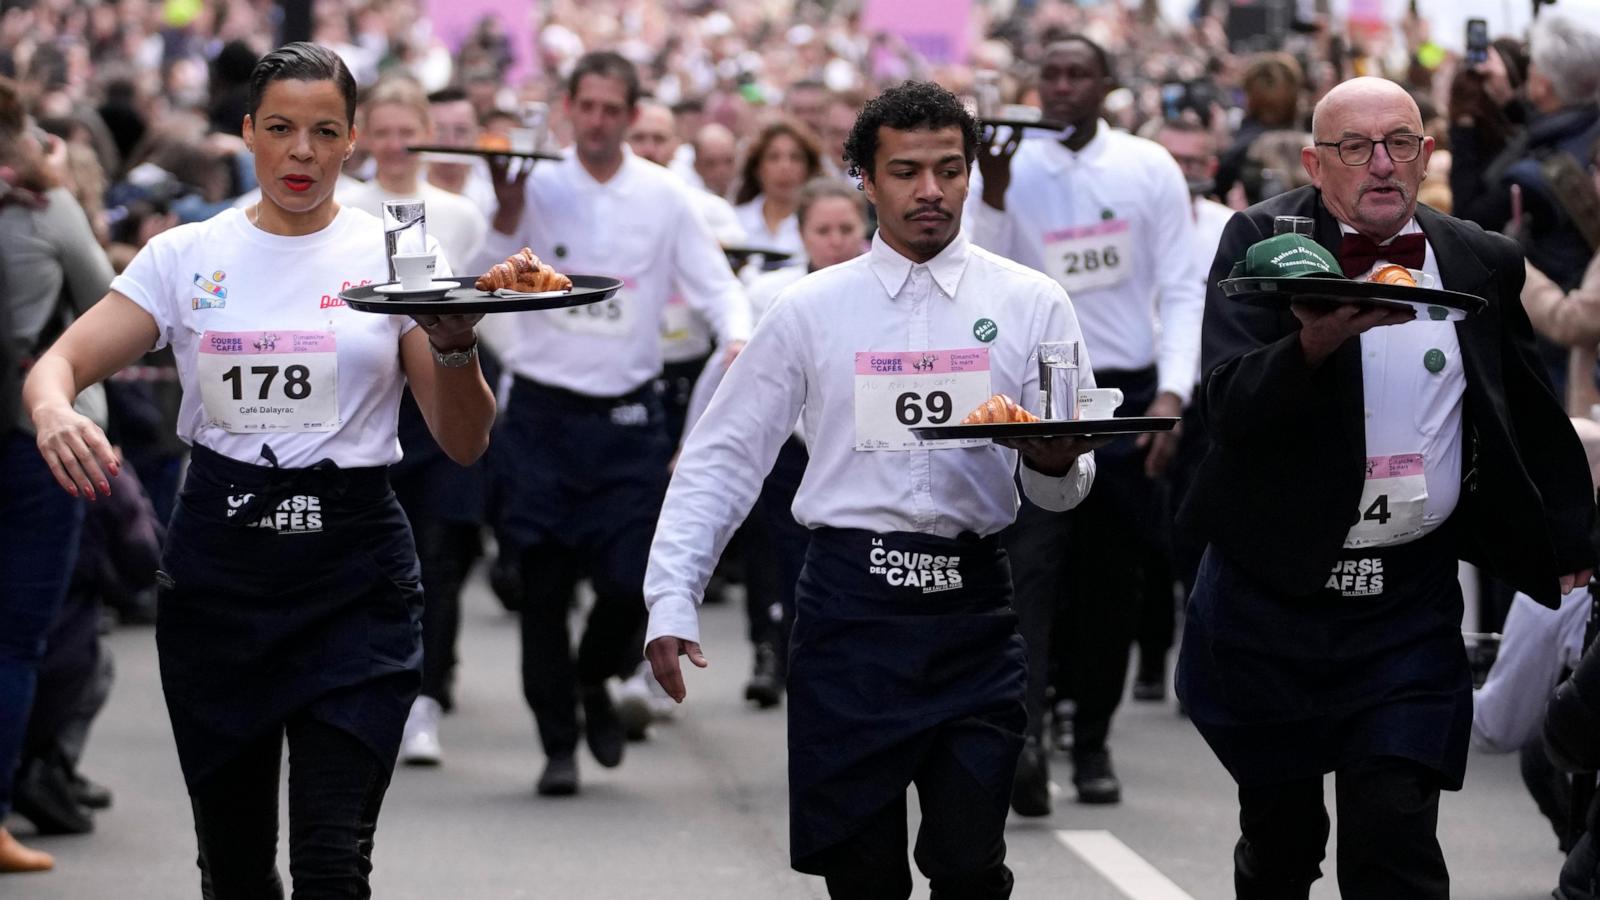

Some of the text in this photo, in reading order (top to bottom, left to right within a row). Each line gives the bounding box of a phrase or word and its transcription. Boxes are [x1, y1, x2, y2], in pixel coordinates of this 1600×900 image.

[1063, 246, 1119, 274] 286
[1271, 248, 1298, 264] Maison
[211, 336, 243, 345] COURSE
[870, 358, 902, 366] COURSE
[222, 364, 312, 401] 178
[239, 406, 295, 416] Café Dalayrac
[895, 390, 953, 426] 69
[872, 538, 883, 546] LA
[869, 547, 961, 570] COURSE
[870, 566, 886, 574] DES
[1324, 573, 1384, 591] AFÉS
